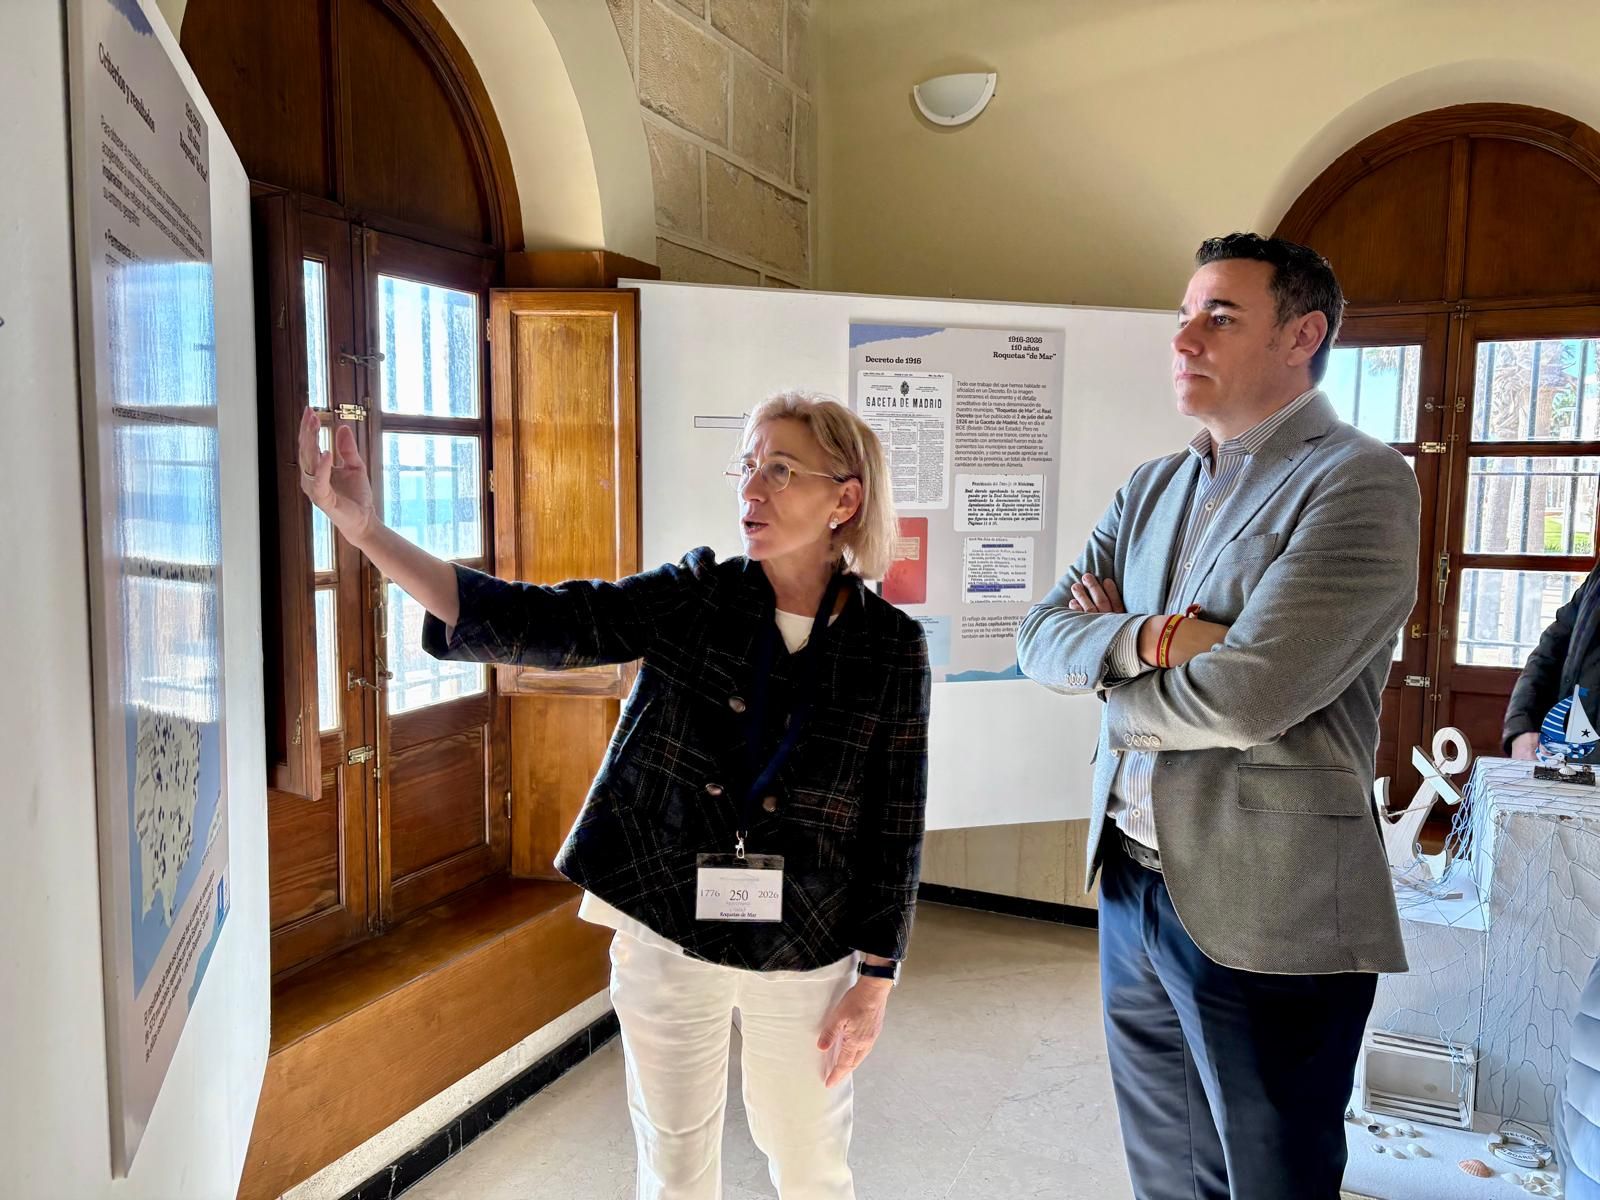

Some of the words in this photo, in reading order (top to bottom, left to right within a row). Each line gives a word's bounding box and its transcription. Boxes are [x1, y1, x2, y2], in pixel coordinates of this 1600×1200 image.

[1008, 336, 1043, 344] 1916-2026
[865, 356, 894, 364] Decreto
[993, 351, 1025, 360] Roquetas
[866, 396, 896, 407] GACETA
[900, 397, 909, 407] DE
[913, 398, 942, 408] MADRID
[700, 889, 720, 897] 1776
[729, 890, 749, 901] 250
[758, 890, 779, 899] 2026
